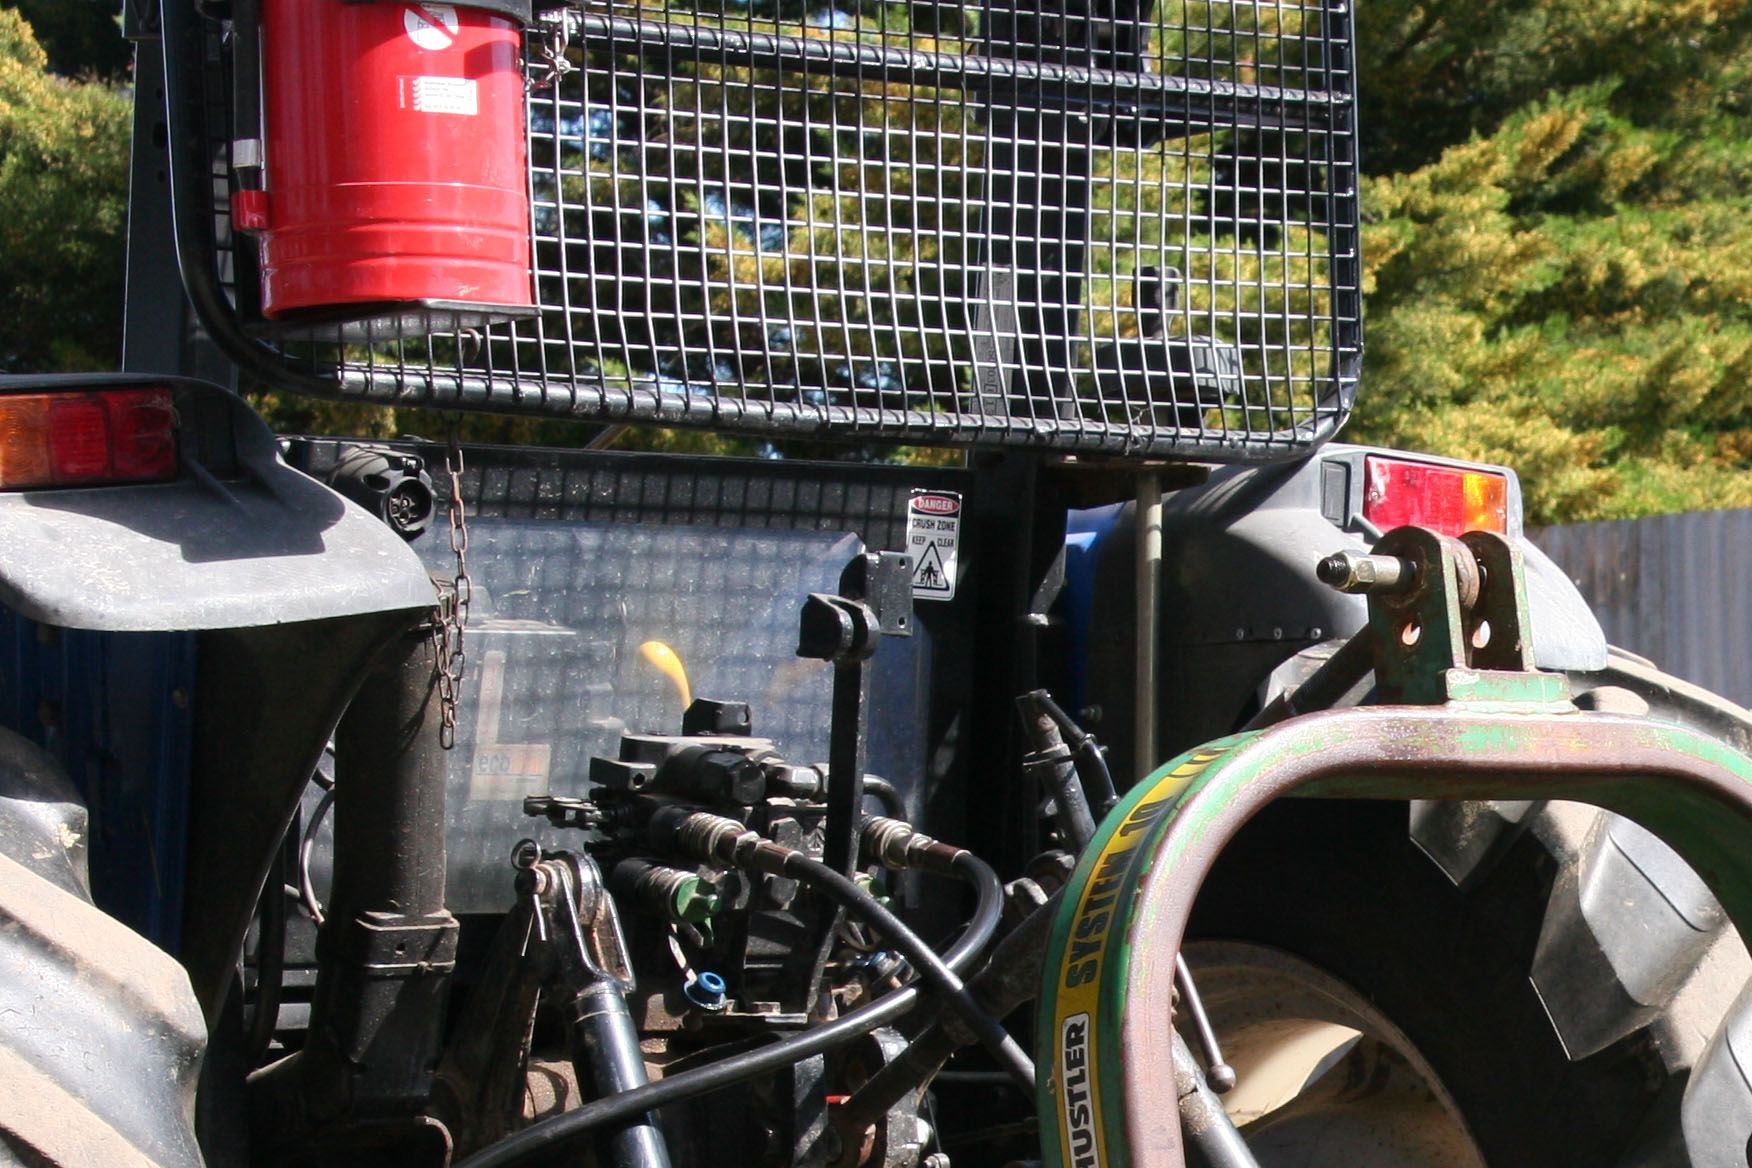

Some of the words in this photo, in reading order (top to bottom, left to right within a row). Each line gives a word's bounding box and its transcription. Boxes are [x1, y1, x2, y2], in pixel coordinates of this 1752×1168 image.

[918, 499, 953, 510] DANGER
[912, 518, 935, 529] CRUSH
[937, 520, 955, 531] ZONE
[912, 536, 926, 545] KEEP
[937, 538, 954, 547] CLEAR
[1066, 848, 1137, 987] SYSTEM
[1121, 795, 1174, 837] 10
